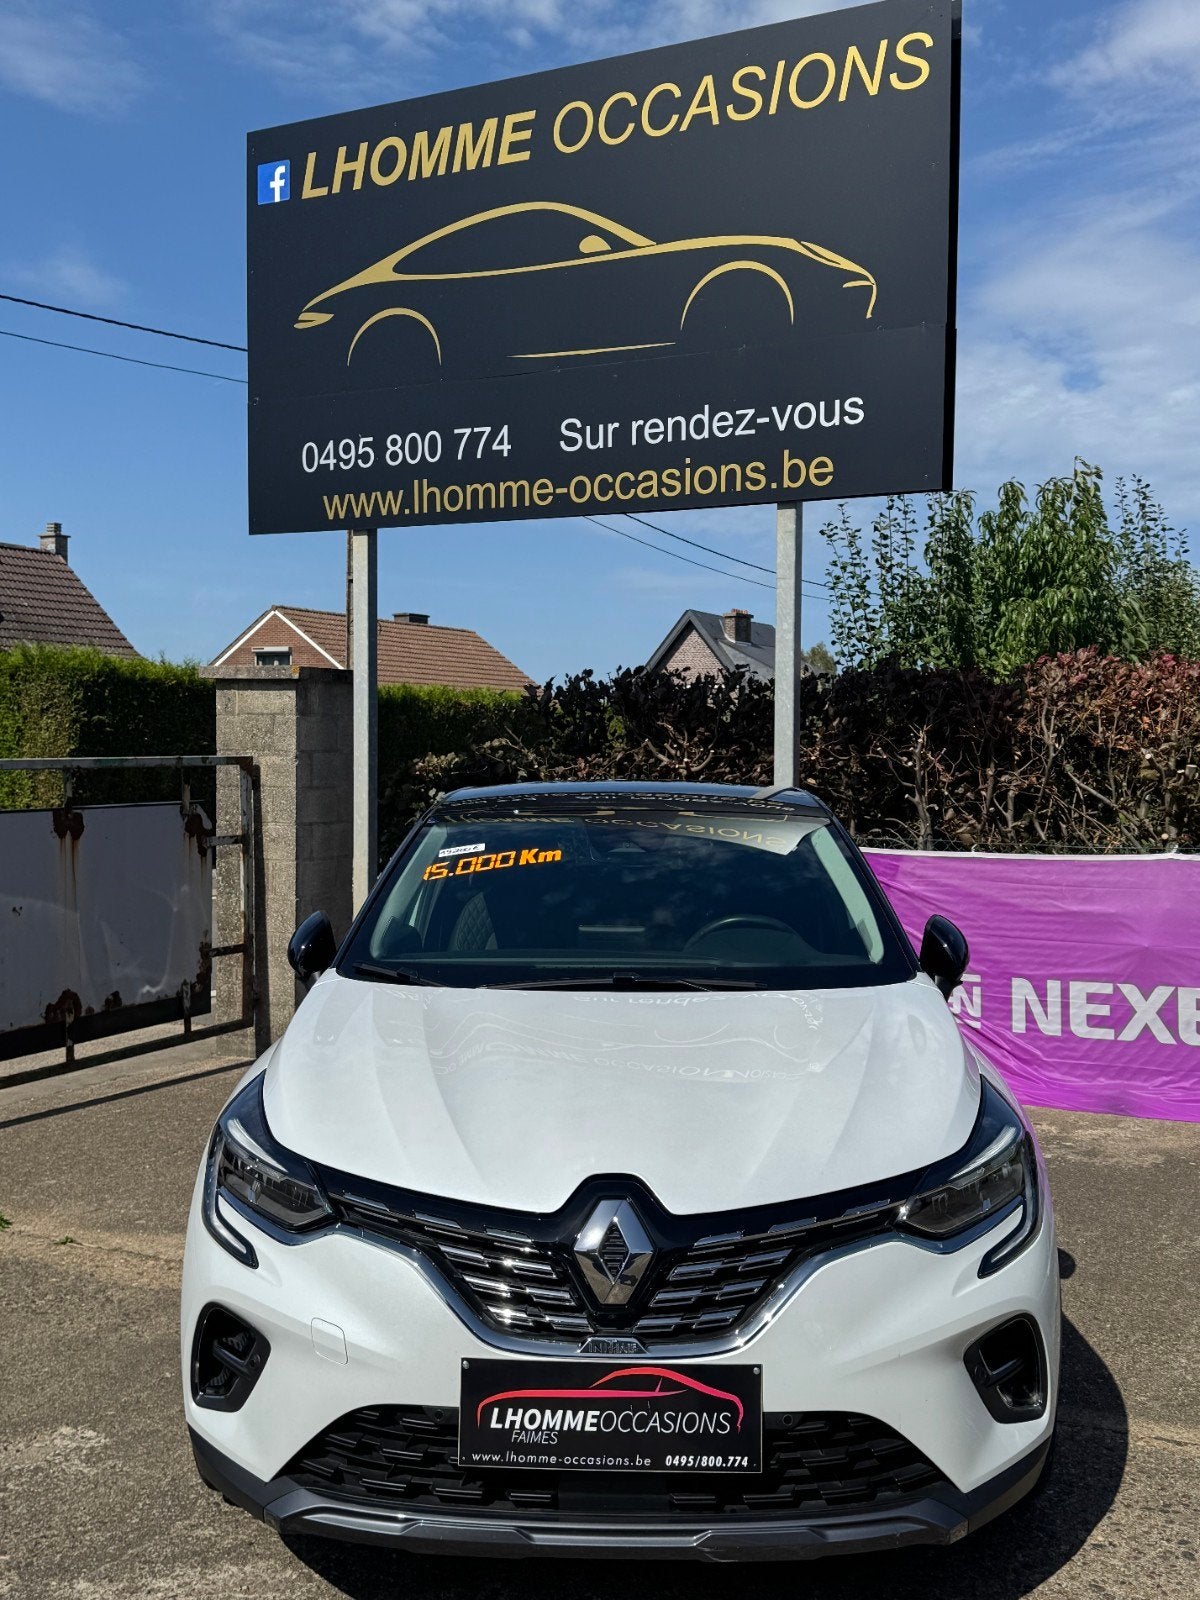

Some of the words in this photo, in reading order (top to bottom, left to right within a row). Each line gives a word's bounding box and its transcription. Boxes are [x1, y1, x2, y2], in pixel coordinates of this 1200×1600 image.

[301, 110, 537, 200] LHOMME
[553, 31, 935, 154] OCCASIONS
[301, 436, 375, 473] 0495
[385, 430, 442, 467] 800
[453, 424, 512, 461] 774
[559, 417, 620, 454] Sur
[631, 396, 866, 447] rendez-vous
[323, 449, 834, 521] www.lhomme-occasions.be
[422, 850, 517, 881] 15.000
[518, 848, 563, 866] Km
[471, 1450, 651, 1467] www.lhomme-occasions.be
[665, 1454, 749, 1468] 0495/800.774
[511, 1429, 559, 1445] FAIMES
